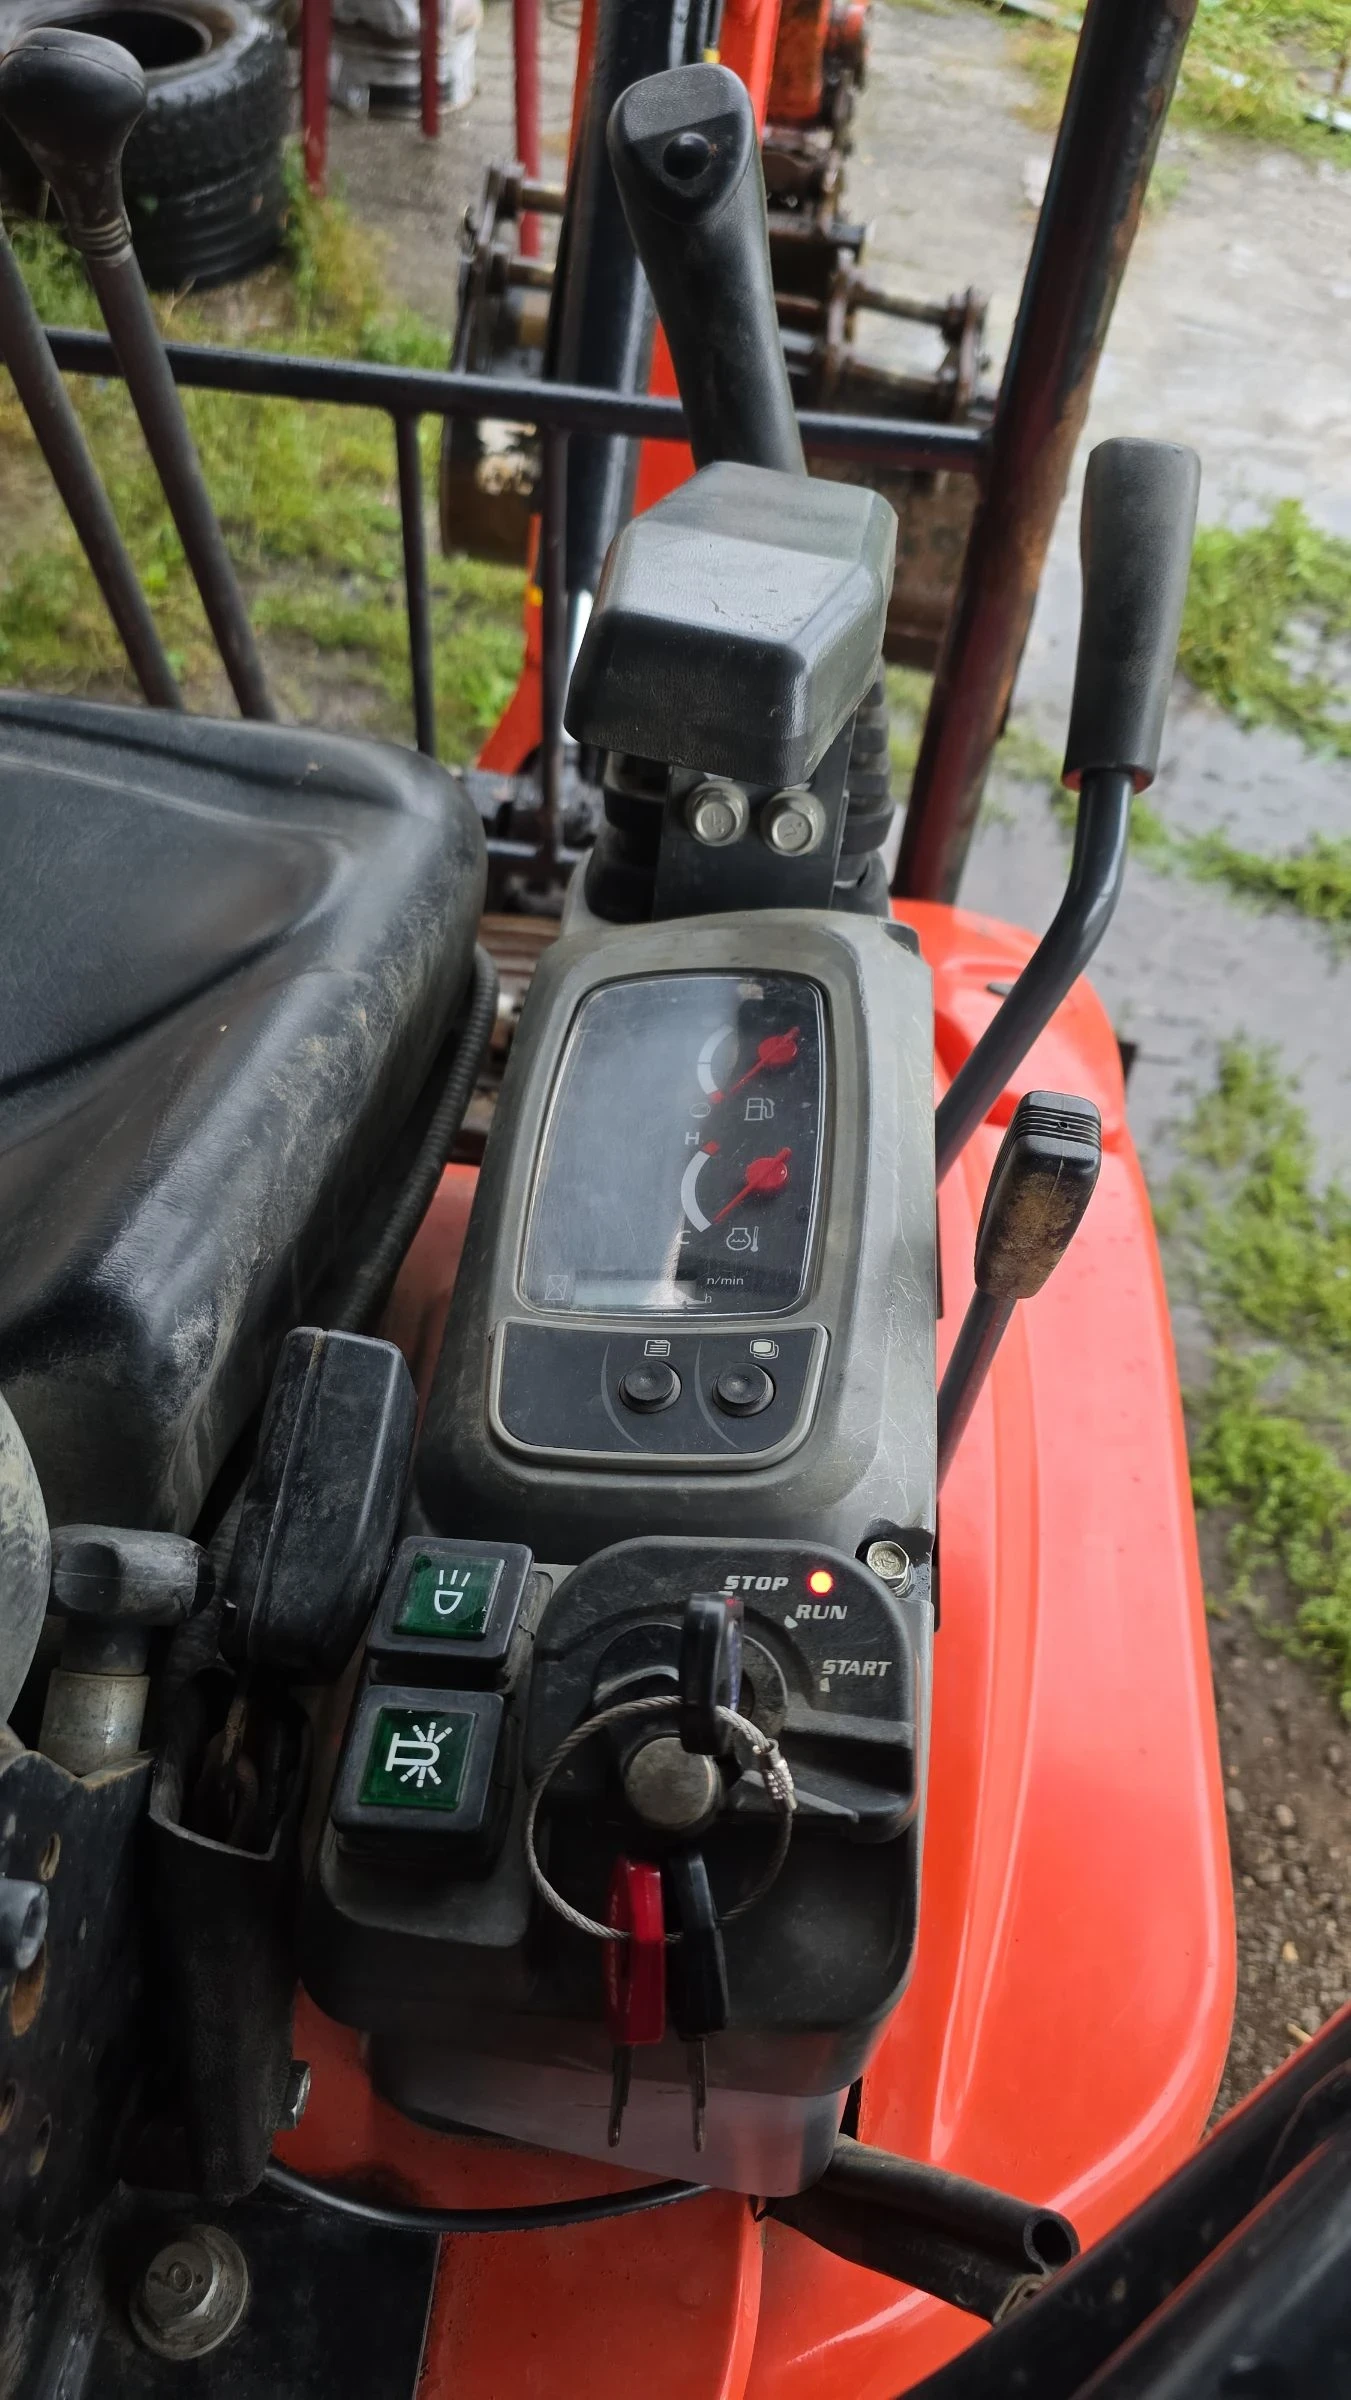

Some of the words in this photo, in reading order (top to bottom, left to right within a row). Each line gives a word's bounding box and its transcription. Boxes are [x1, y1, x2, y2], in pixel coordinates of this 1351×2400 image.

[684, 1132, 700, 1145] H
[676, 1230, 691, 1245] C
[706, 1275, 744, 1286] n/min
[724, 1575, 789, 1591] STOP
[795, 1604, 848, 1620] RUN
[821, 1659, 892, 1677] START
